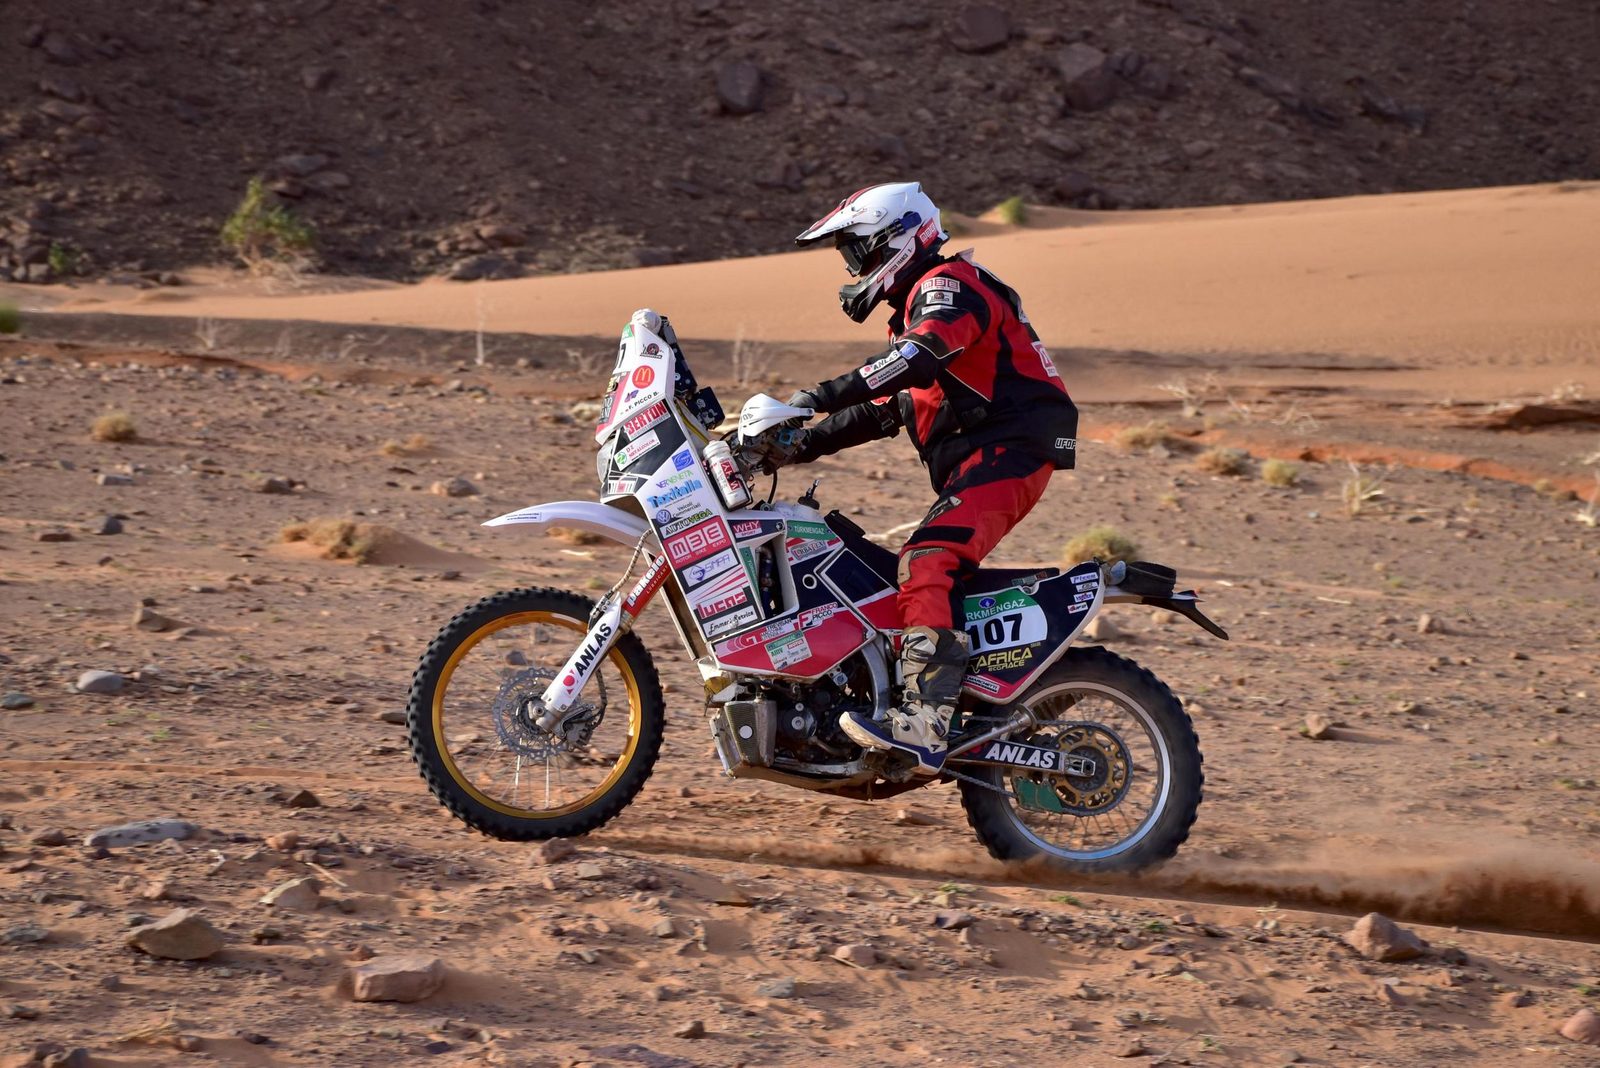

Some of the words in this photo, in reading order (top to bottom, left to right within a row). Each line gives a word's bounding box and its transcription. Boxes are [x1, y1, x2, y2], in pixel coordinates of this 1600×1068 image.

[634, 394, 652, 407] PICCO
[733, 521, 759, 533] WHY
[712, 539, 727, 548] EXPO
[810, 602, 838, 614] FRANCO
[812, 609, 832, 620] PICCO
[967, 612, 1023, 650] 107
[573, 622, 612, 677] ANLAS
[978, 647, 1033, 667] AFRICA
[985, 743, 1055, 769] ANLAS
